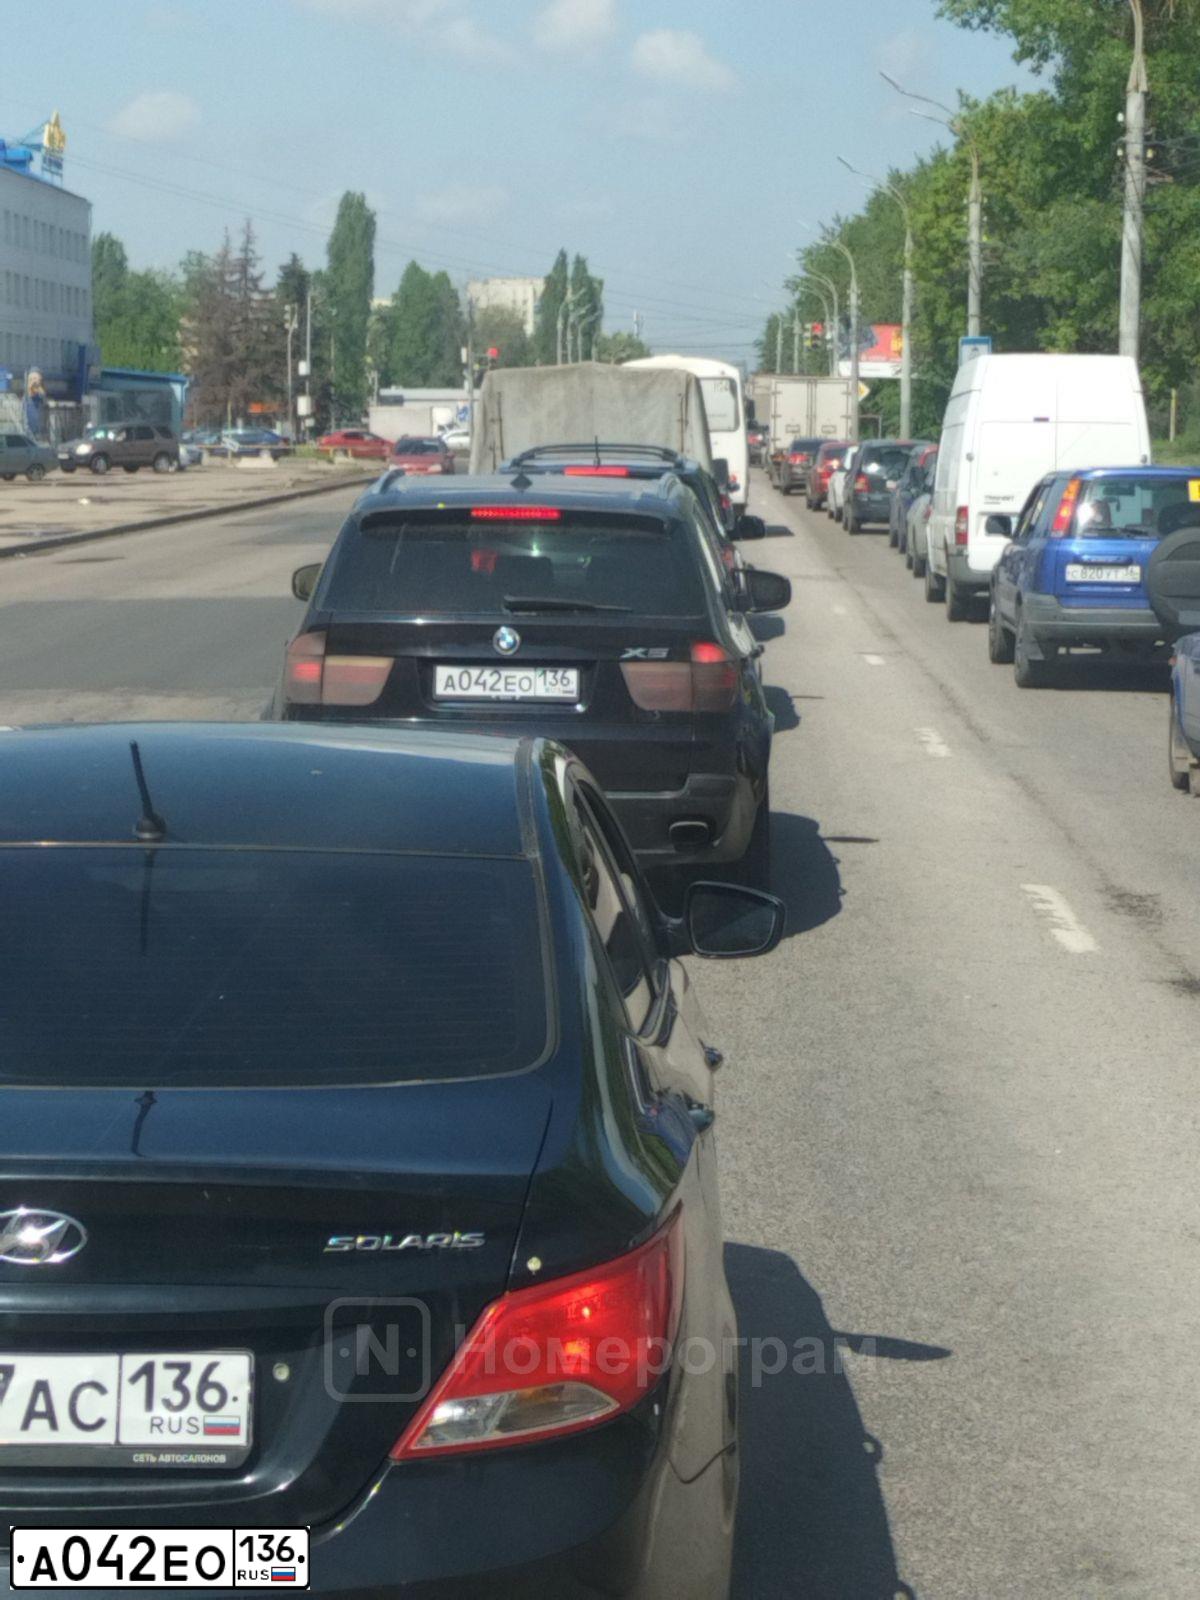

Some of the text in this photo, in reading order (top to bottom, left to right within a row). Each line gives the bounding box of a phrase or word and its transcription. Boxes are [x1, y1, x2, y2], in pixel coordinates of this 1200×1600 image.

[620, 647, 670, 659] X5
[443, 669, 571, 693] А042ЕО 136
[323, 1231, 486, 1252] SOLARIS
[128, 1360, 229, 1413] 136
[149, 1416, 201, 1435] RUS
[132, 1453, 227, 1464] СЕТЬ АВТОСАЛОНОВ
